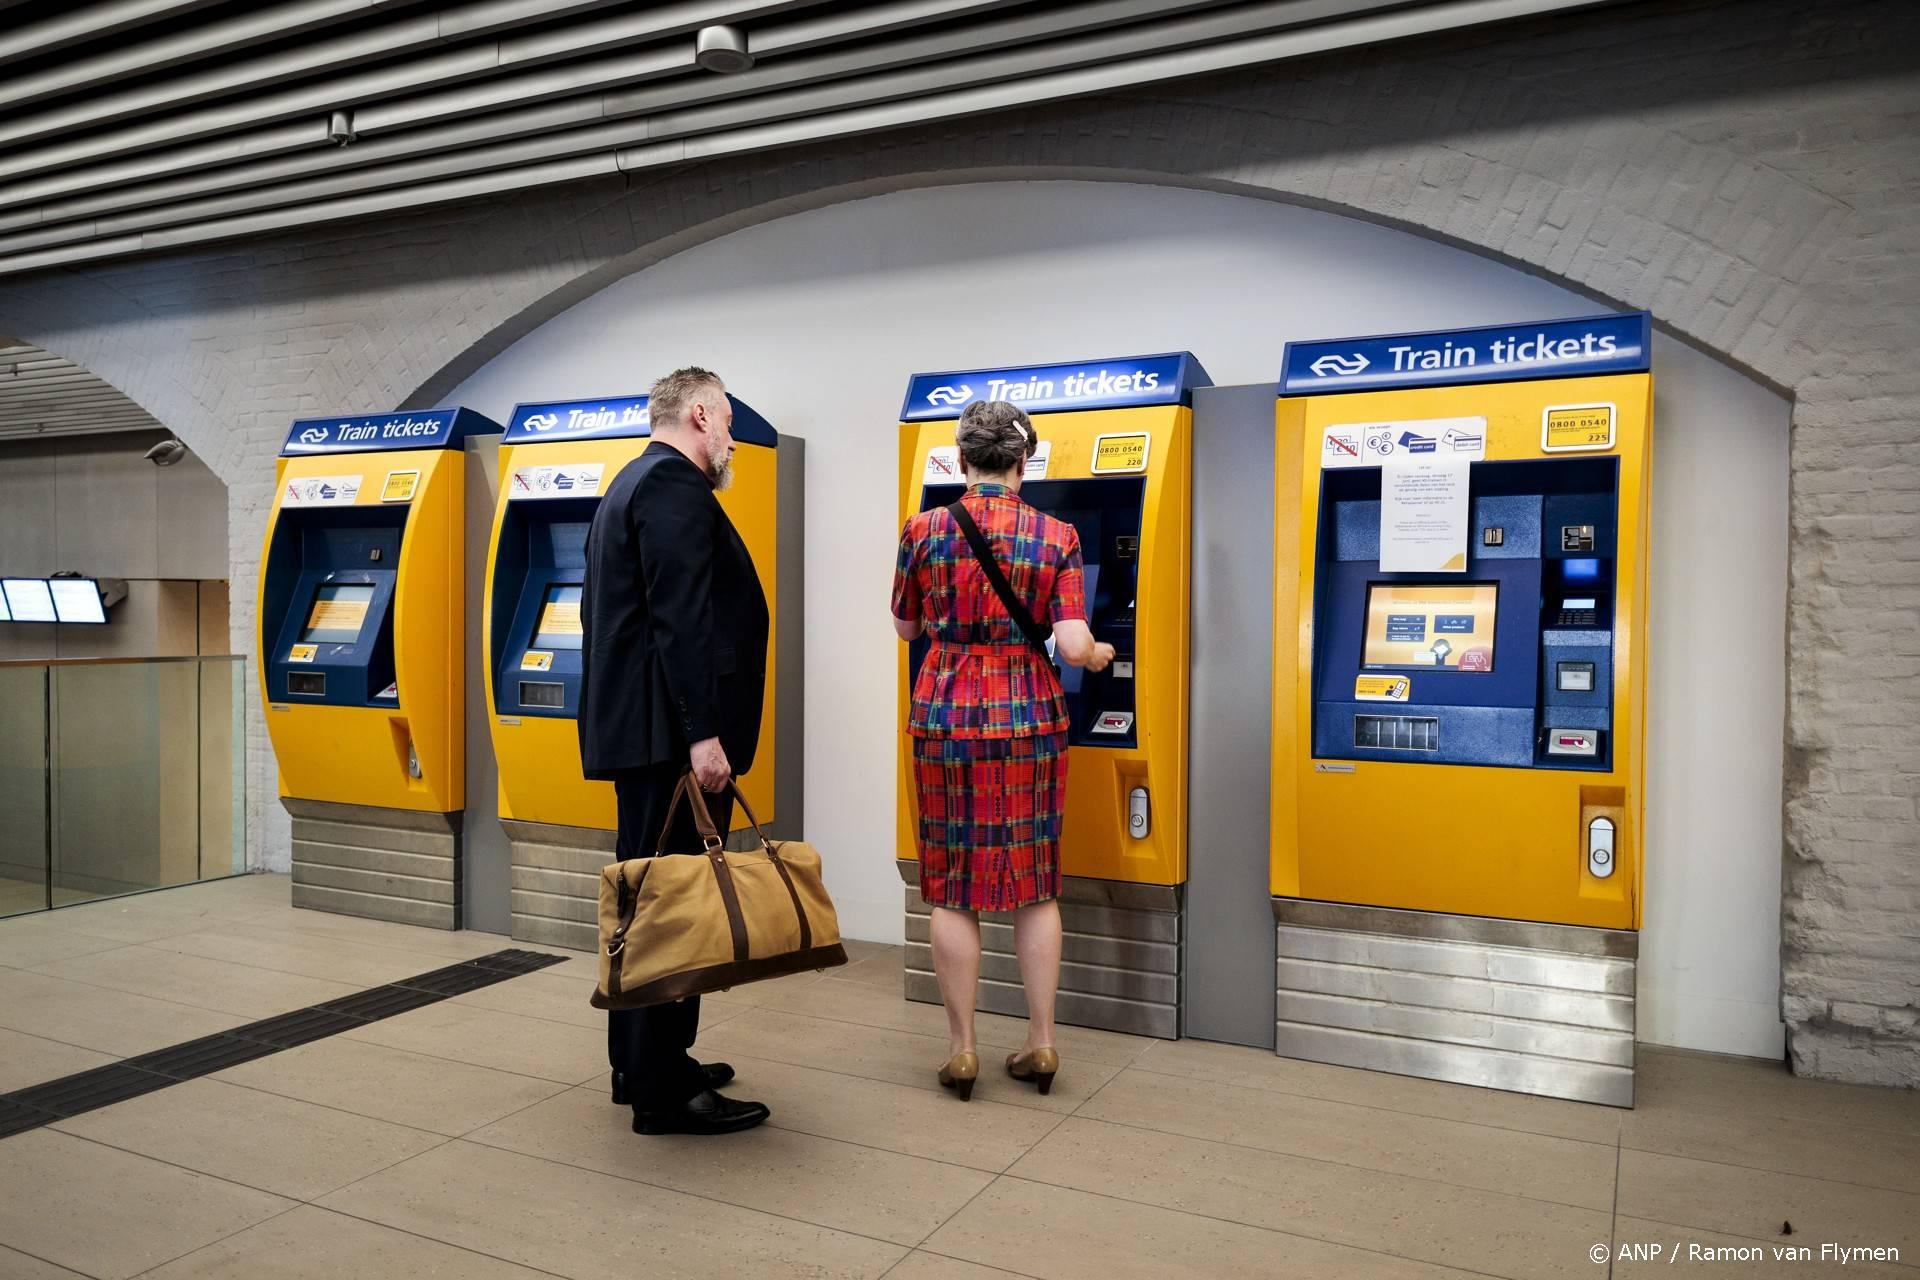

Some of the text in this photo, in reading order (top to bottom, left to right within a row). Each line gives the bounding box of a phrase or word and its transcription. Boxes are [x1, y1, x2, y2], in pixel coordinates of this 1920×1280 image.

[1389, 332, 1616, 371] Train tickets
[987, 369, 1158, 402] Train tickets
[337, 418, 441, 441] Train tickets
[567, 407, 616, 429] Train
[1581, 419, 1607, 427] 0540
